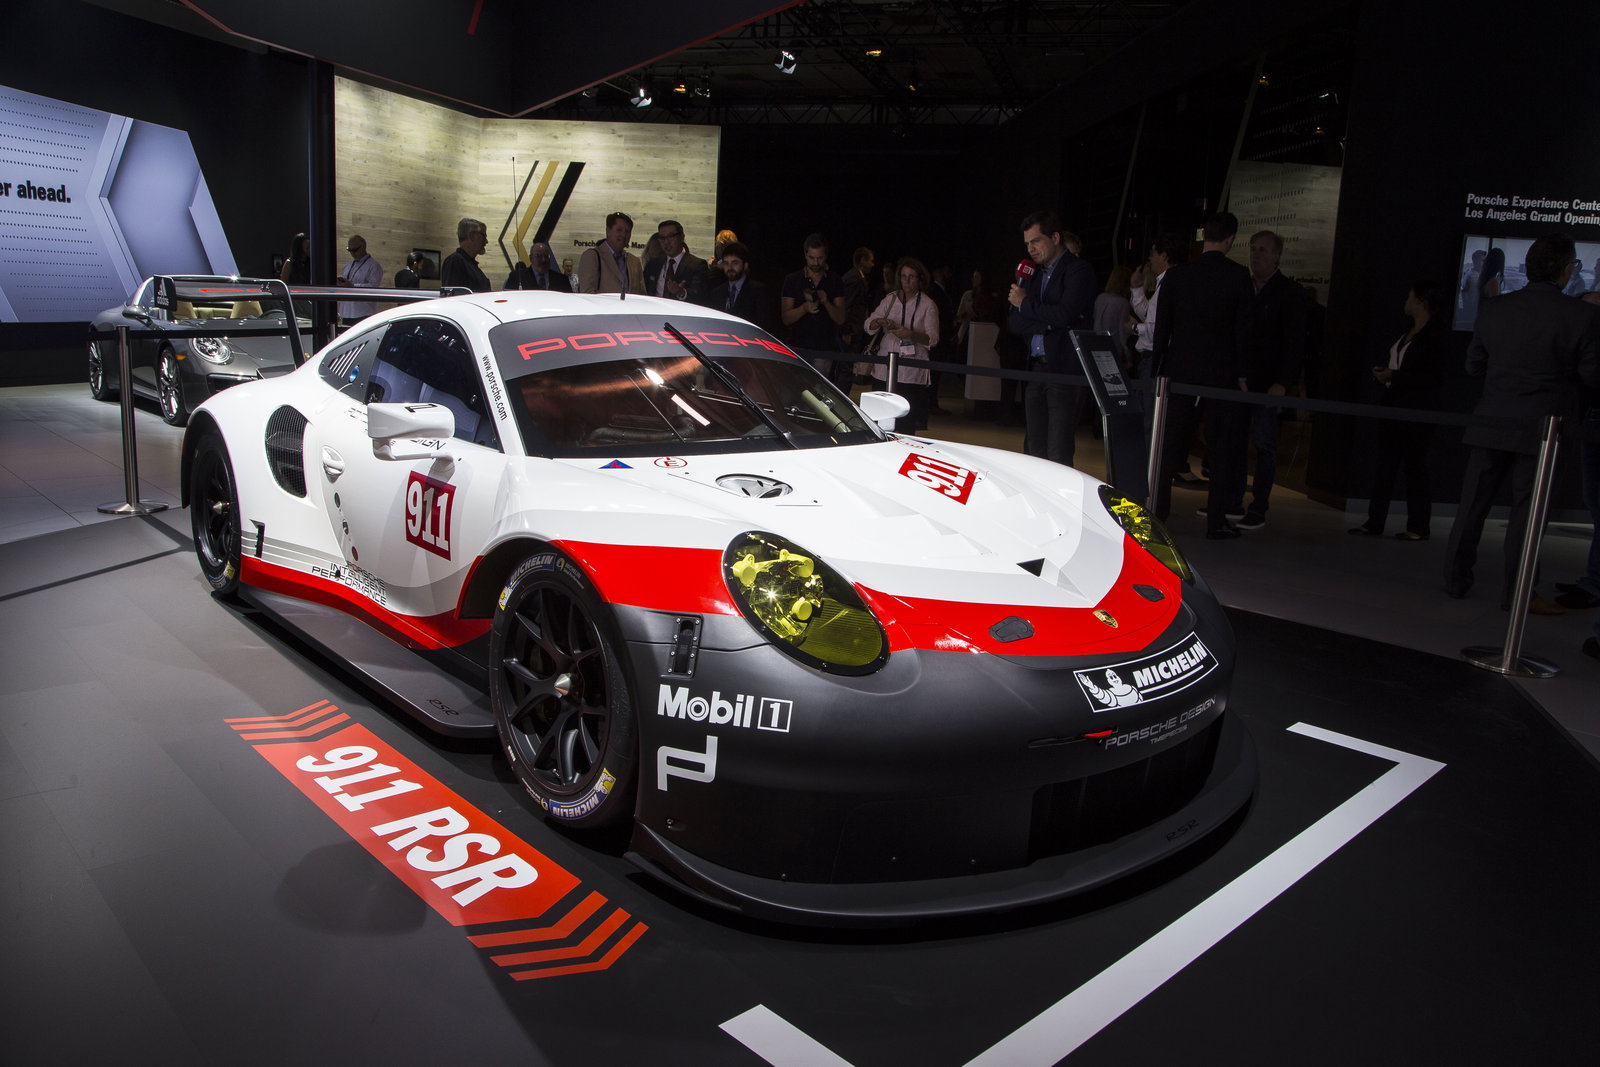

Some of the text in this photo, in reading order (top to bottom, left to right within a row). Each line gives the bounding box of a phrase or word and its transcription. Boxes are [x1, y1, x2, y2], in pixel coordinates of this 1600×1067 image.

[17, 180, 71, 203] ahead.
[1467, 193, 1509, 206] Porsche
[1511, 195, 1569, 209] Experience
[1465, 207, 1600, 227] Los Angeles Grand Openin
[517, 331, 798, 361] PORSCHE
[482, 354, 508, 421] www.porsche.com
[907, 456, 969, 497] 911
[407, 480, 449, 552] 911
[510, 555, 554, 585] MICHELIN
[1132, 640, 1208, 689] MICHELIN
[657, 683, 755, 728] Mobil
[1105, 695, 1218, 750] PORSCHE DESIGN
[552, 793, 600, 818] MICHELIN
[296, 745, 539, 908] 911 RSR
